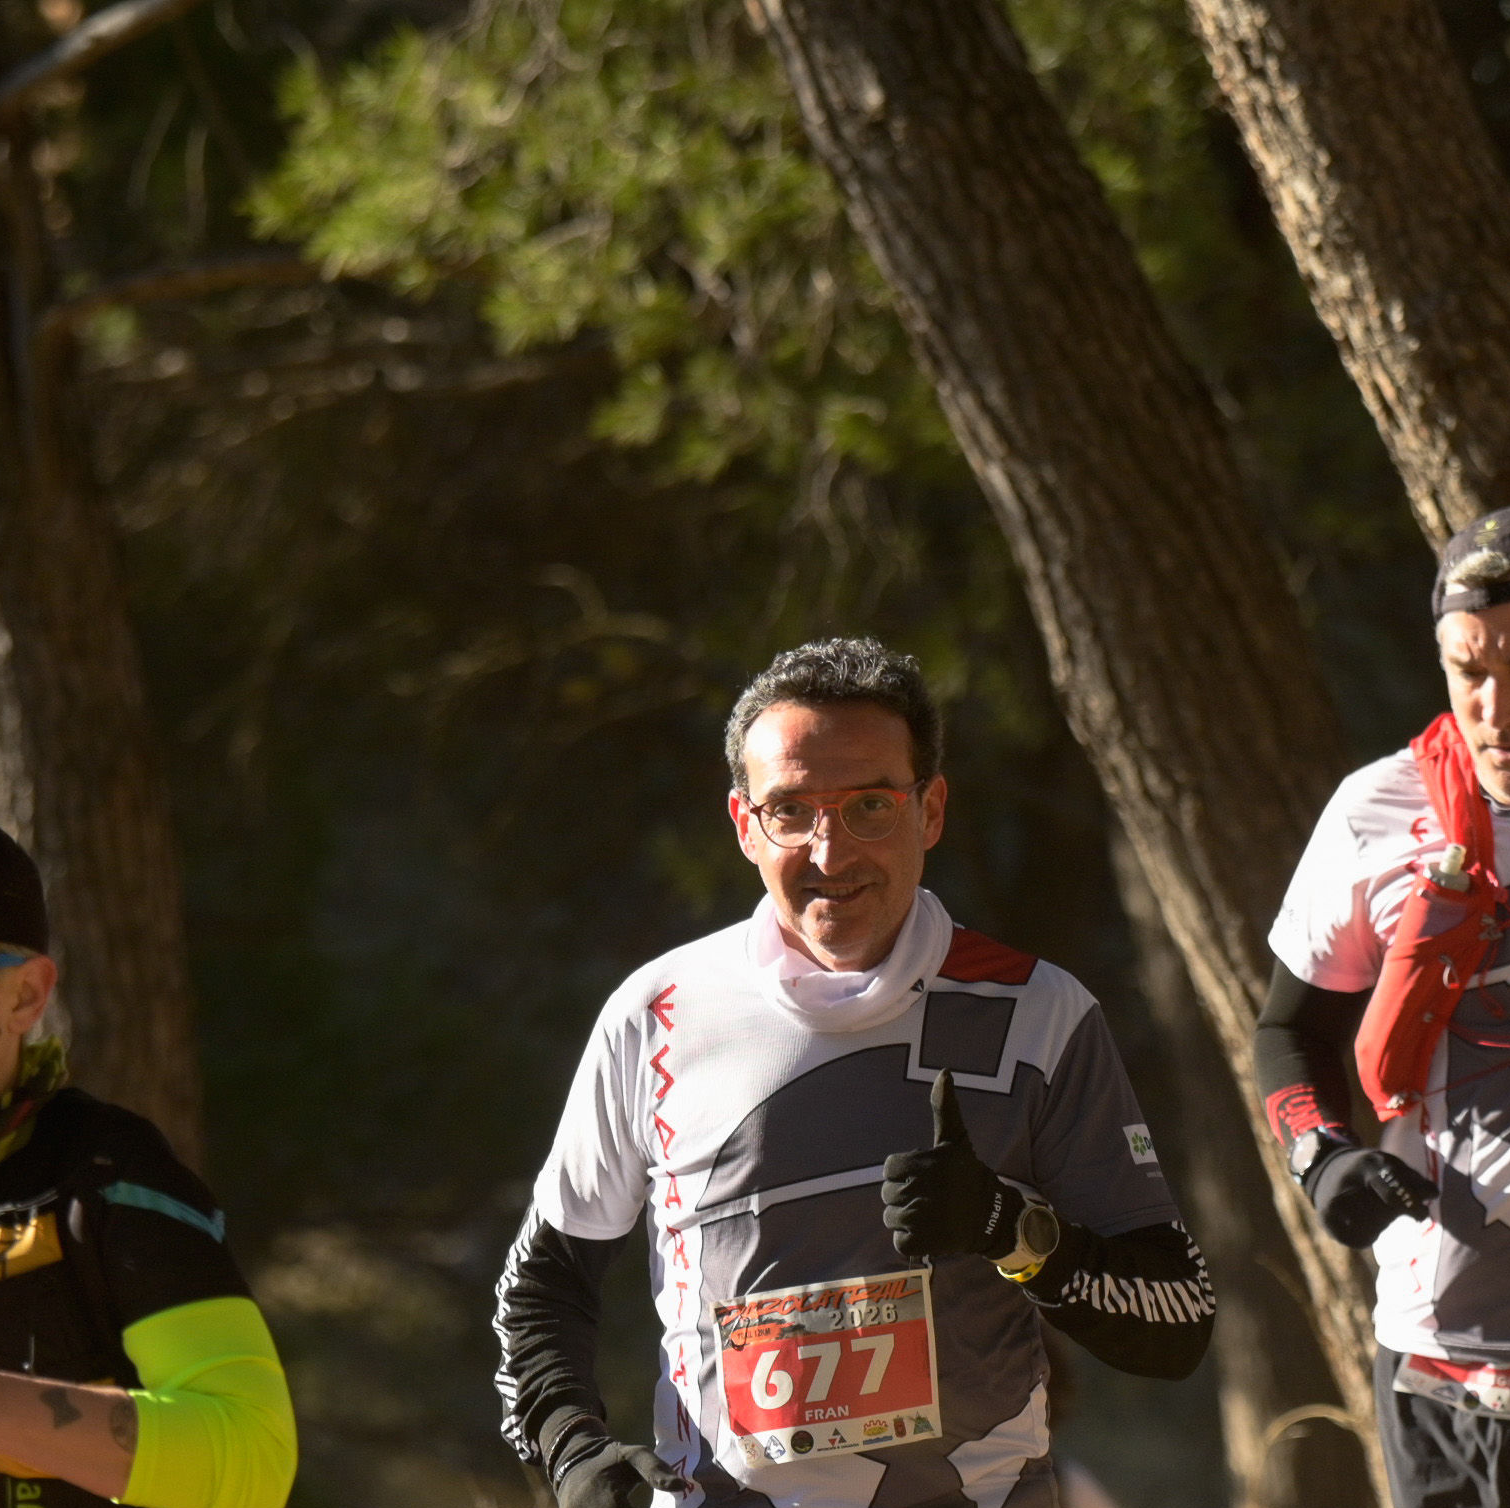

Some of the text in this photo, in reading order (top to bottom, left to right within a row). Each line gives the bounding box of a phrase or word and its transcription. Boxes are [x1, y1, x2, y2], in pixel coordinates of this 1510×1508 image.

[984, 1192, 1003, 1236] KIPRUN
[829, 1303, 898, 1330] 2026
[750, 1333, 895, 1410] 677
[805, 1405, 850, 1421] FRAN
